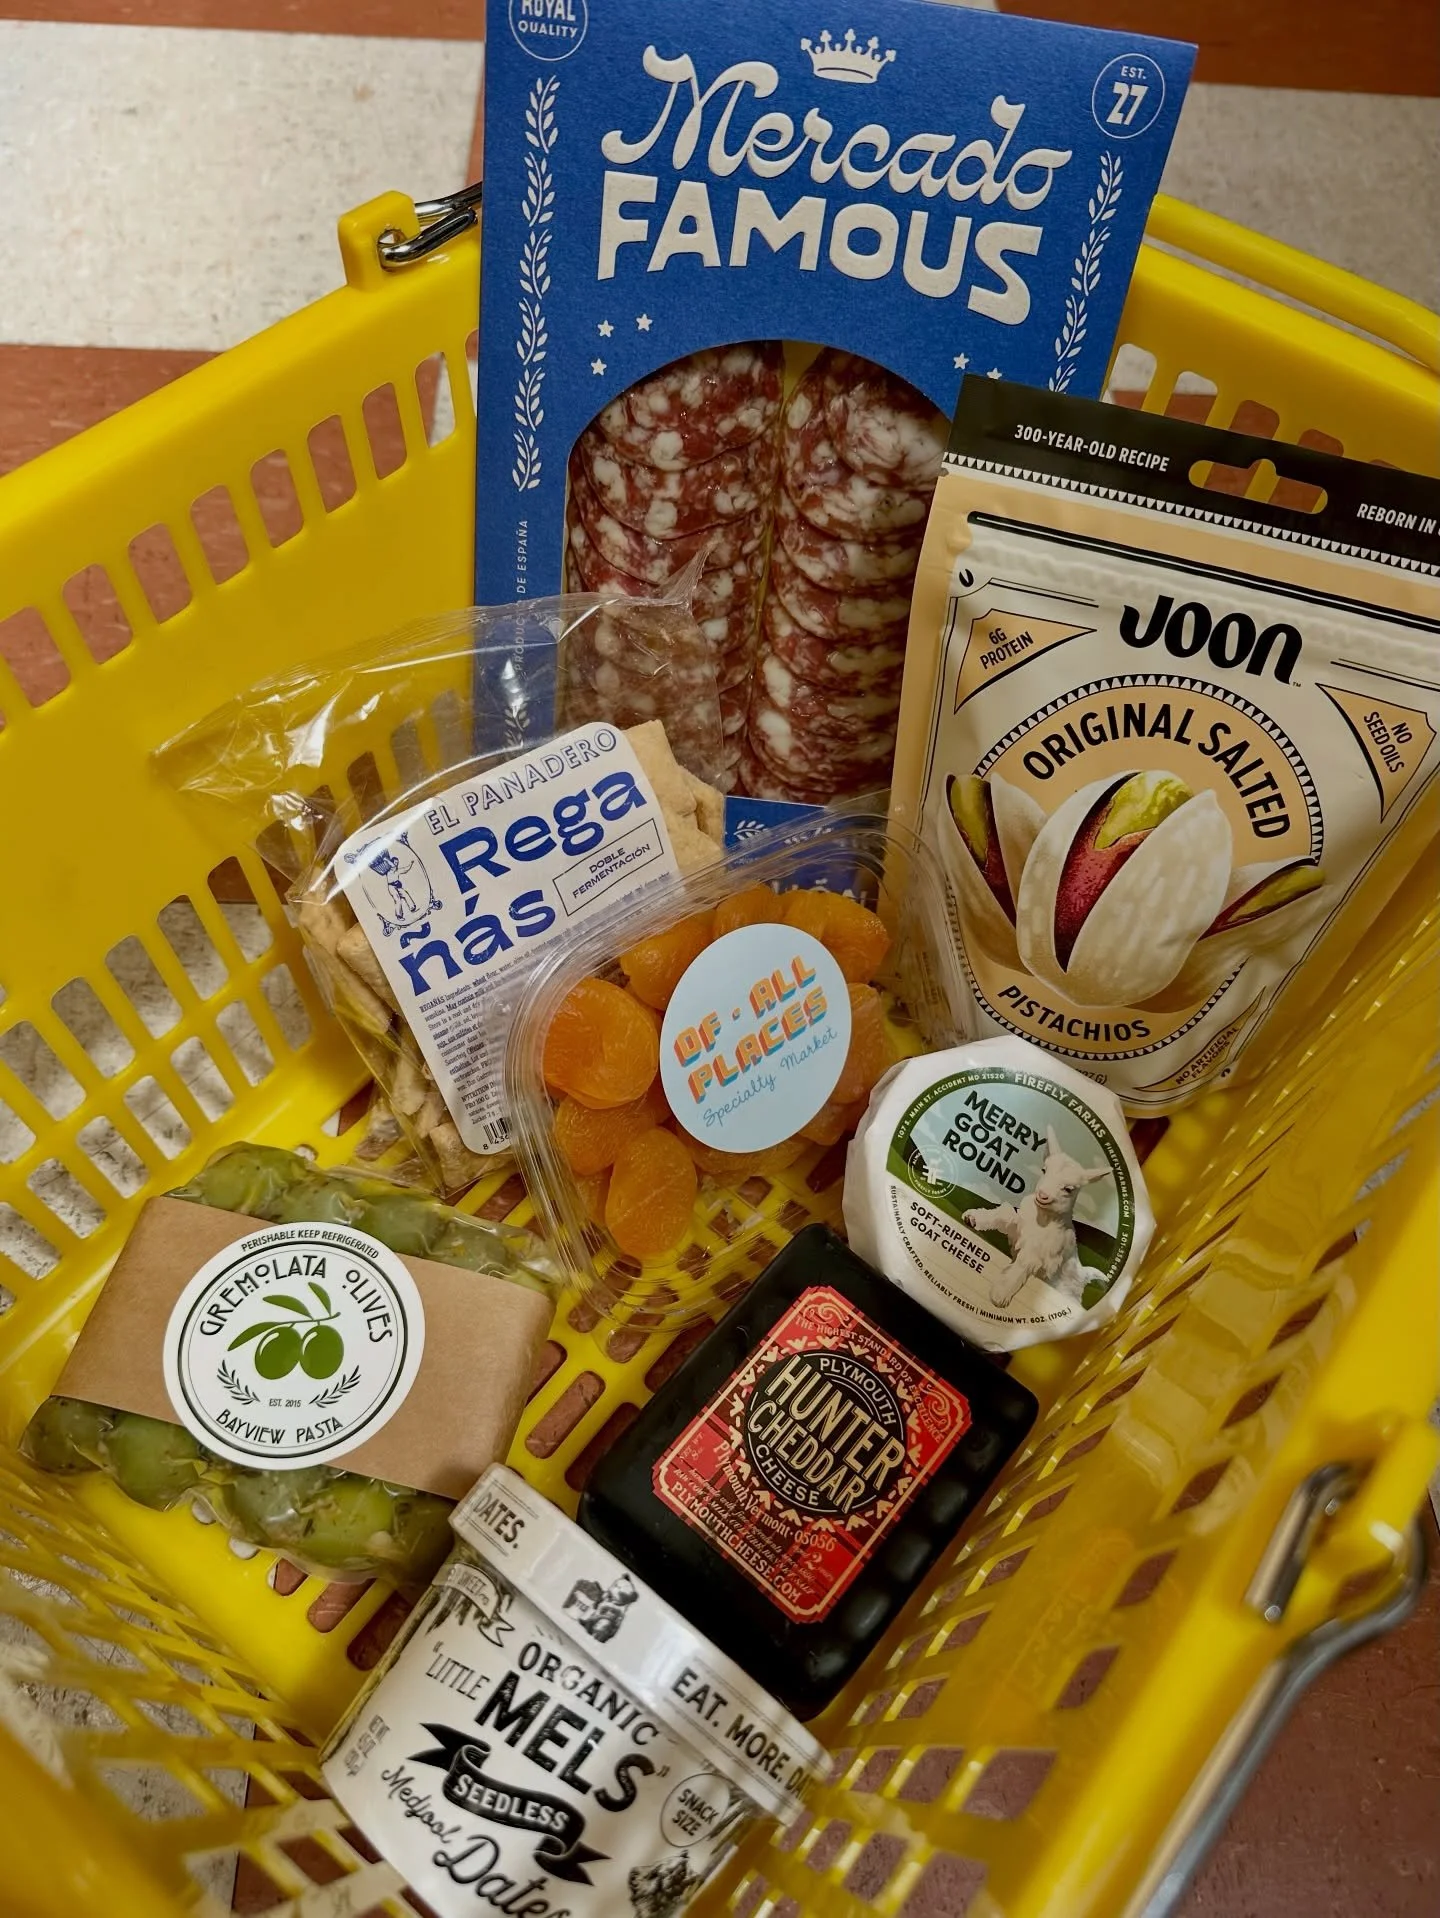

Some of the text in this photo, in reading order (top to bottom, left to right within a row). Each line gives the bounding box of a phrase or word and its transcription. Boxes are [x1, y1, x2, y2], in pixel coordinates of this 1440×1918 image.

[518, 20, 578, 38] QUALITY
[521, 0, 576, 20] ROYAL
[1120, 64, 1147, 80] EST.
[601, 45, 1072, 211] Mercado
[1108, 82, 1150, 126] 27
[597, 171, 1043, 325] FAMOUS
[1013, 424, 1170, 472] 300-YEAR-OLD RECIPE
[516, 519, 528, 571] ESPAÑA
[1356, 503, 1417, 530] REBORN
[1418, 517, 1437, 534] IN
[516, 577, 527, 594] DE
[980, 630, 1034, 671] PROTEIN
[988, 627, 1008, 644] 6G
[1363, 711, 1405, 773] SEED OILS
[1391, 722, 1412, 744] NO
[424, 728, 617, 836] EL PANADERO
[1023, 703, 1291, 839] ORIGINAL SALTED
[438, 771, 648, 894] Rega
[588, 847, 627, 875] DOBLE
[572, 843, 651, 899] FERMENTACIÓN
[398, 889, 556, 997] ñás
[674, 955, 816, 1068] OF ALL
[997, 984, 1151, 1042] PISTACHIOS
[688, 986, 828, 1105] PLACES
[1175, 1027, 1239, 1084] NO ARTIFICIAL
[1191, 1041, 1230, 1078] FLAVORS
[703, 1025, 838, 1128] Specialty Market
[908, 1100, 925, 1119] MAIN
[932, 1074, 966, 1098] ACCIDENT
[966, 1072, 979, 1082] MD
[1014, 1072, 1067, 1101] FIREFLY
[1068, 1098, 1105, 1138] FARMS
[954, 1112, 1020, 1163] GOAT
[963, 1090, 1048, 1153] MERRY
[942, 1129, 1026, 1195] ROUND
[241, 1229, 379, 1259] PERISHABLE KEEP REFRIGERATED
[890, 1185, 905, 1236] SUSTAINABLY
[903, 1236, 924, 1271] CRAFTED,
[920, 1268, 954, 1298] RELIABLY
[950, 1294, 976, 1312] FRESH
[978, 1309, 1013, 1323] MINIMUM
[909, 1217, 985, 1275] GOAT CHEESE
[910, 1201, 991, 1264] SOFT-RIPENED
[200, 1255, 393, 1343] GREMOLATA OLIVES
[268, 1398, 302, 1408] EST. 2015
[794, 1318, 944, 1444] THE HIGHEST STANDARD OF EXCELLENCE
[820, 1357, 897, 1426] PLYMOUTH
[216, 1409, 343, 1445] BAYVIEW PASTA
[766, 1354, 905, 1491] HUNTER
[748, 1400, 866, 1514] CHEDDAR
[756, 1444, 819, 1507] CHEESE
[473, 1486, 526, 1551] DATES.
[671, 1480, 802, 1604] PLYMOUTHCHEESE.COM
[794, 1529, 837, 1551] 05056
[803, 1549, 824, 1571] 2
[517, 1641, 659, 1747] ORGANIC
[672, 1667, 728, 1728] EAT.
[381, 1765, 463, 1845] Medjool
[452, 1773, 570, 1831] SEEDLESS
[672, 1810, 704, 1837] SIZE
[678, 1788, 720, 1825] SNACK
